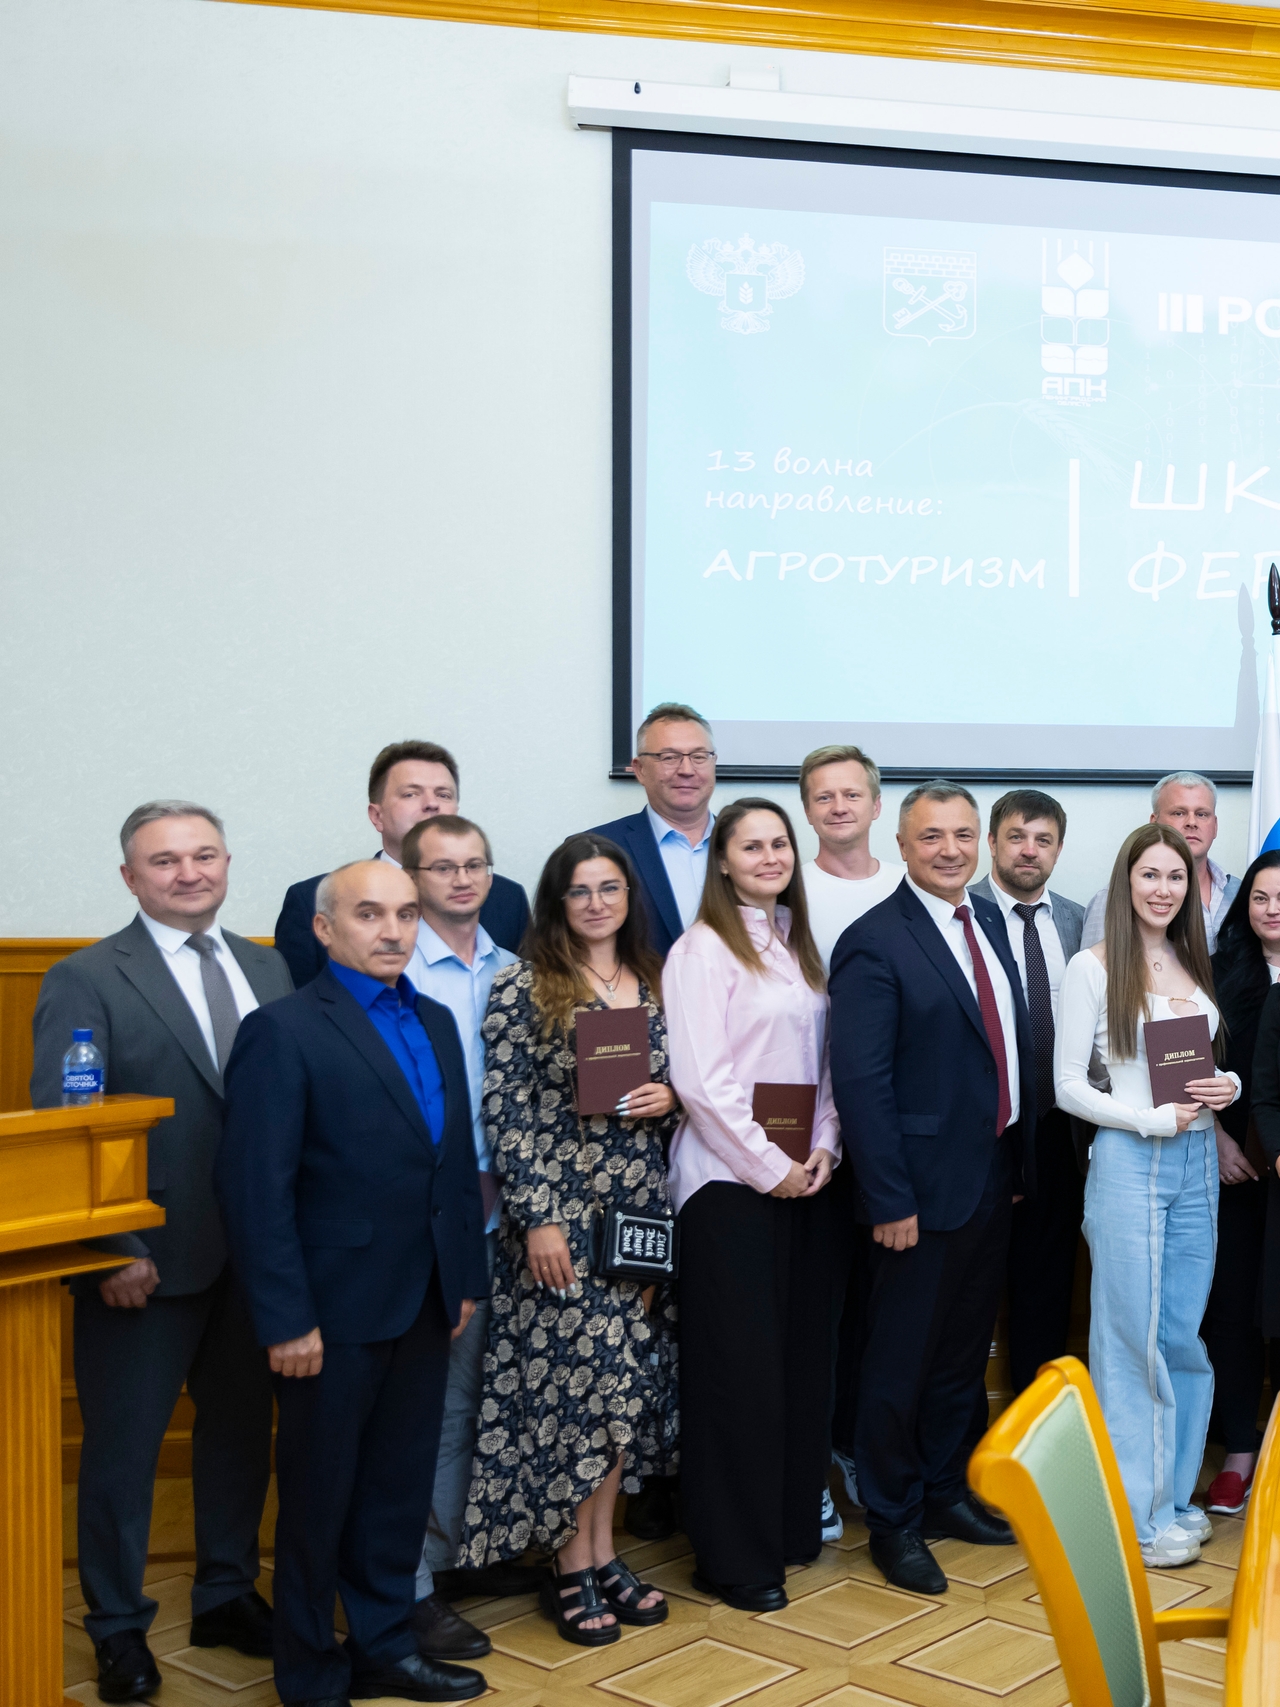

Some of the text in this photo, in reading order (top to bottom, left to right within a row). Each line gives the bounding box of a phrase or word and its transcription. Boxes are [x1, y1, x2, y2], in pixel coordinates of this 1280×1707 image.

[1041, 376, 1107, 398] АПК
[706, 446, 874, 477] 13 волна
[705, 485, 944, 519] направление:
[702, 548, 1047, 589] АГРОТУРИЗМ
[595, 1043, 631, 1055] ДИПЛОМ
[1164, 1049, 1196, 1061] ДИПЛОМ
[766, 1117, 798, 1126] ДИПЛОМ
[622, 1226, 633, 1253] Book
[634, 1225, 645, 1257] Magic
[645, 1227, 656, 1257] Black
[656, 1230, 667, 1259] Little
